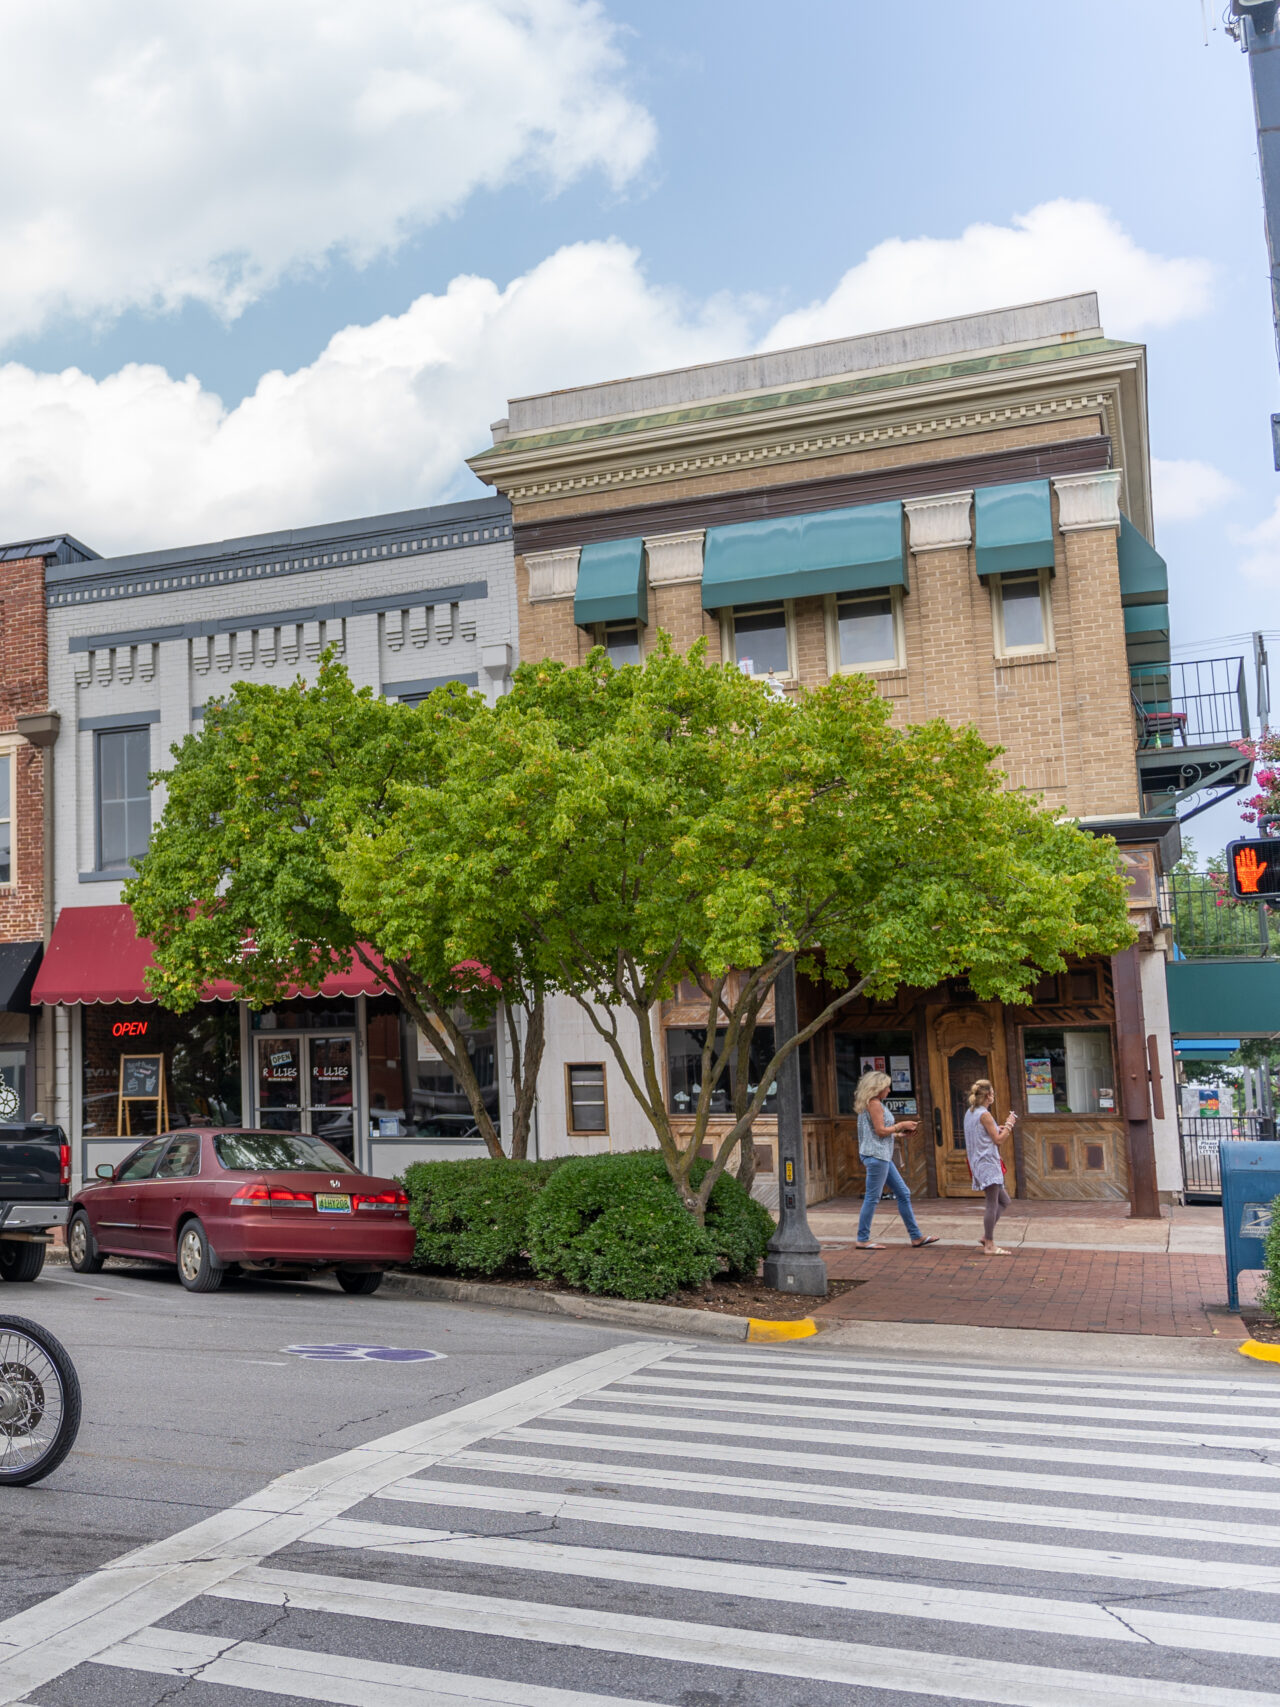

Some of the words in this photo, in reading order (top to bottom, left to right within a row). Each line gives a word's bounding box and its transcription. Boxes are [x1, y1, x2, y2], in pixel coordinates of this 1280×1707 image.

[112, 1021, 148, 1037] OPEN
[272, 1053, 291, 1064] OPEN
[886, 1100, 905, 1111] OPE
